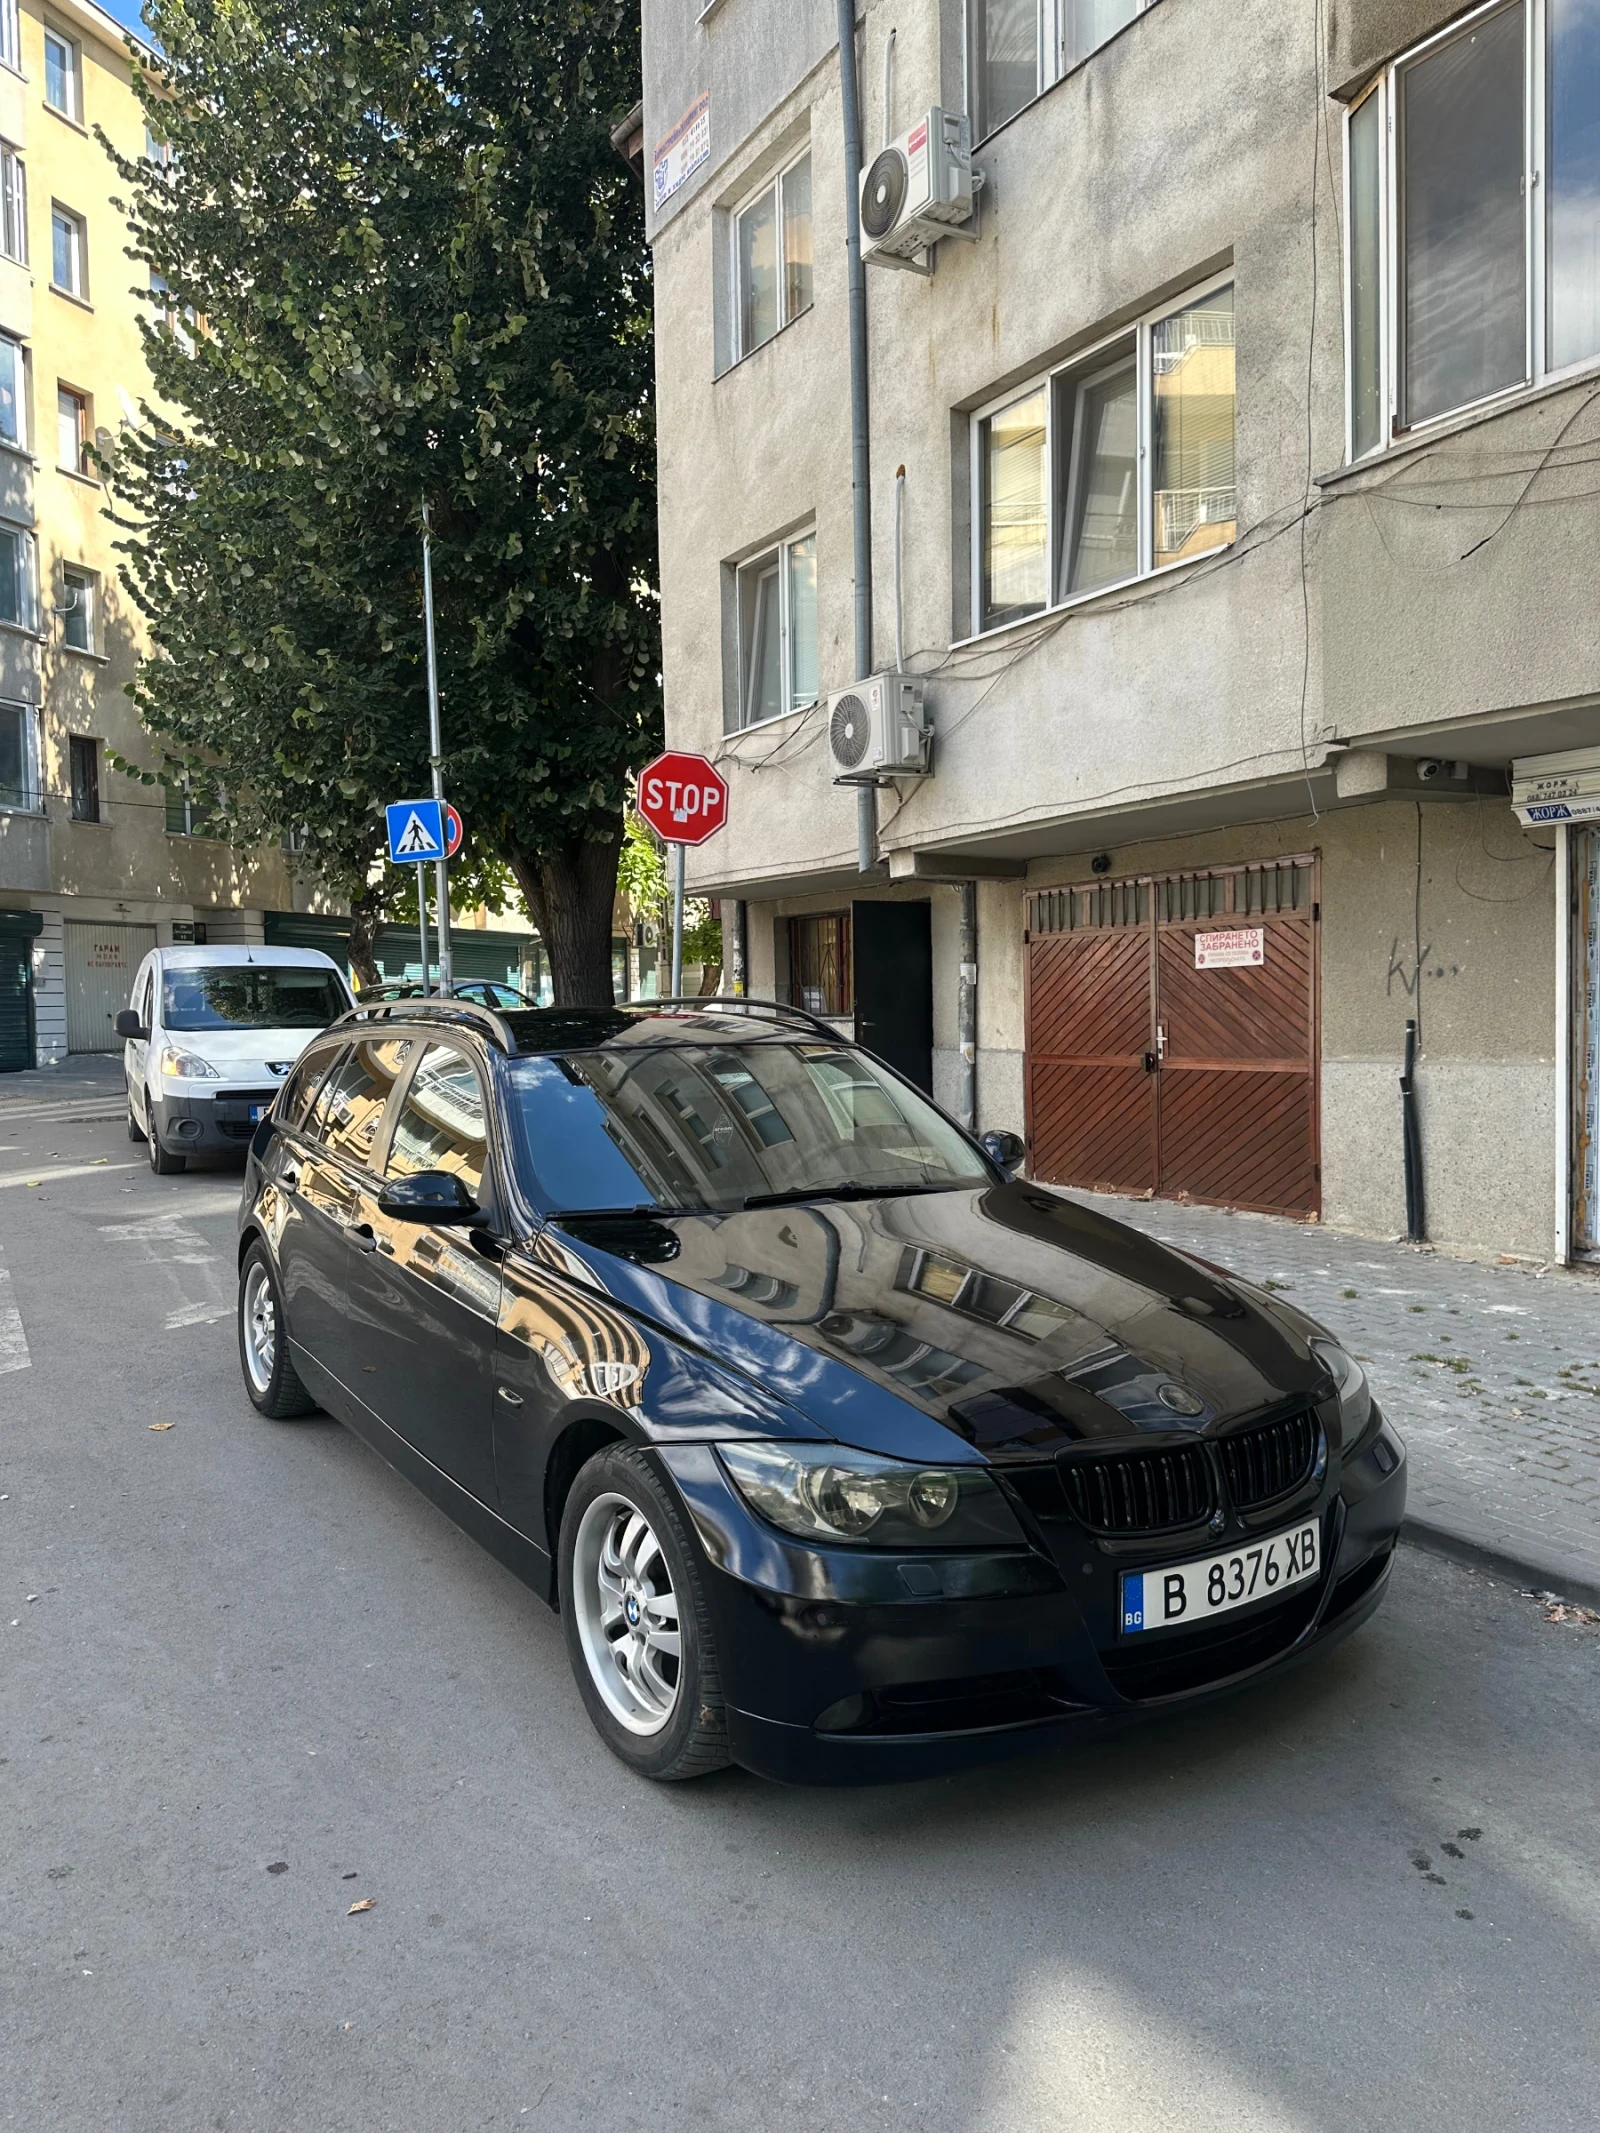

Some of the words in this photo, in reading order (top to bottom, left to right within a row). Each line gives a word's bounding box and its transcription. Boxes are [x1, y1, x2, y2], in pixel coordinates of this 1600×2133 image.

[1537, 780, 1567, 790] ЖОРЖ
[646, 778, 720, 816] STOP
[1531, 805, 1568, 819] ЖОРЖ
[1200, 930, 1258, 942] СПИРАНЕТО
[1200, 939, 1259, 951] ЗАБРАНЕНО
[1164, 1573, 1187, 1619] B
[1207, 1543, 1280, 1606] 8376
[1285, 1527, 1316, 1580] XB
[1125, 1611, 1142, 1626] BG
